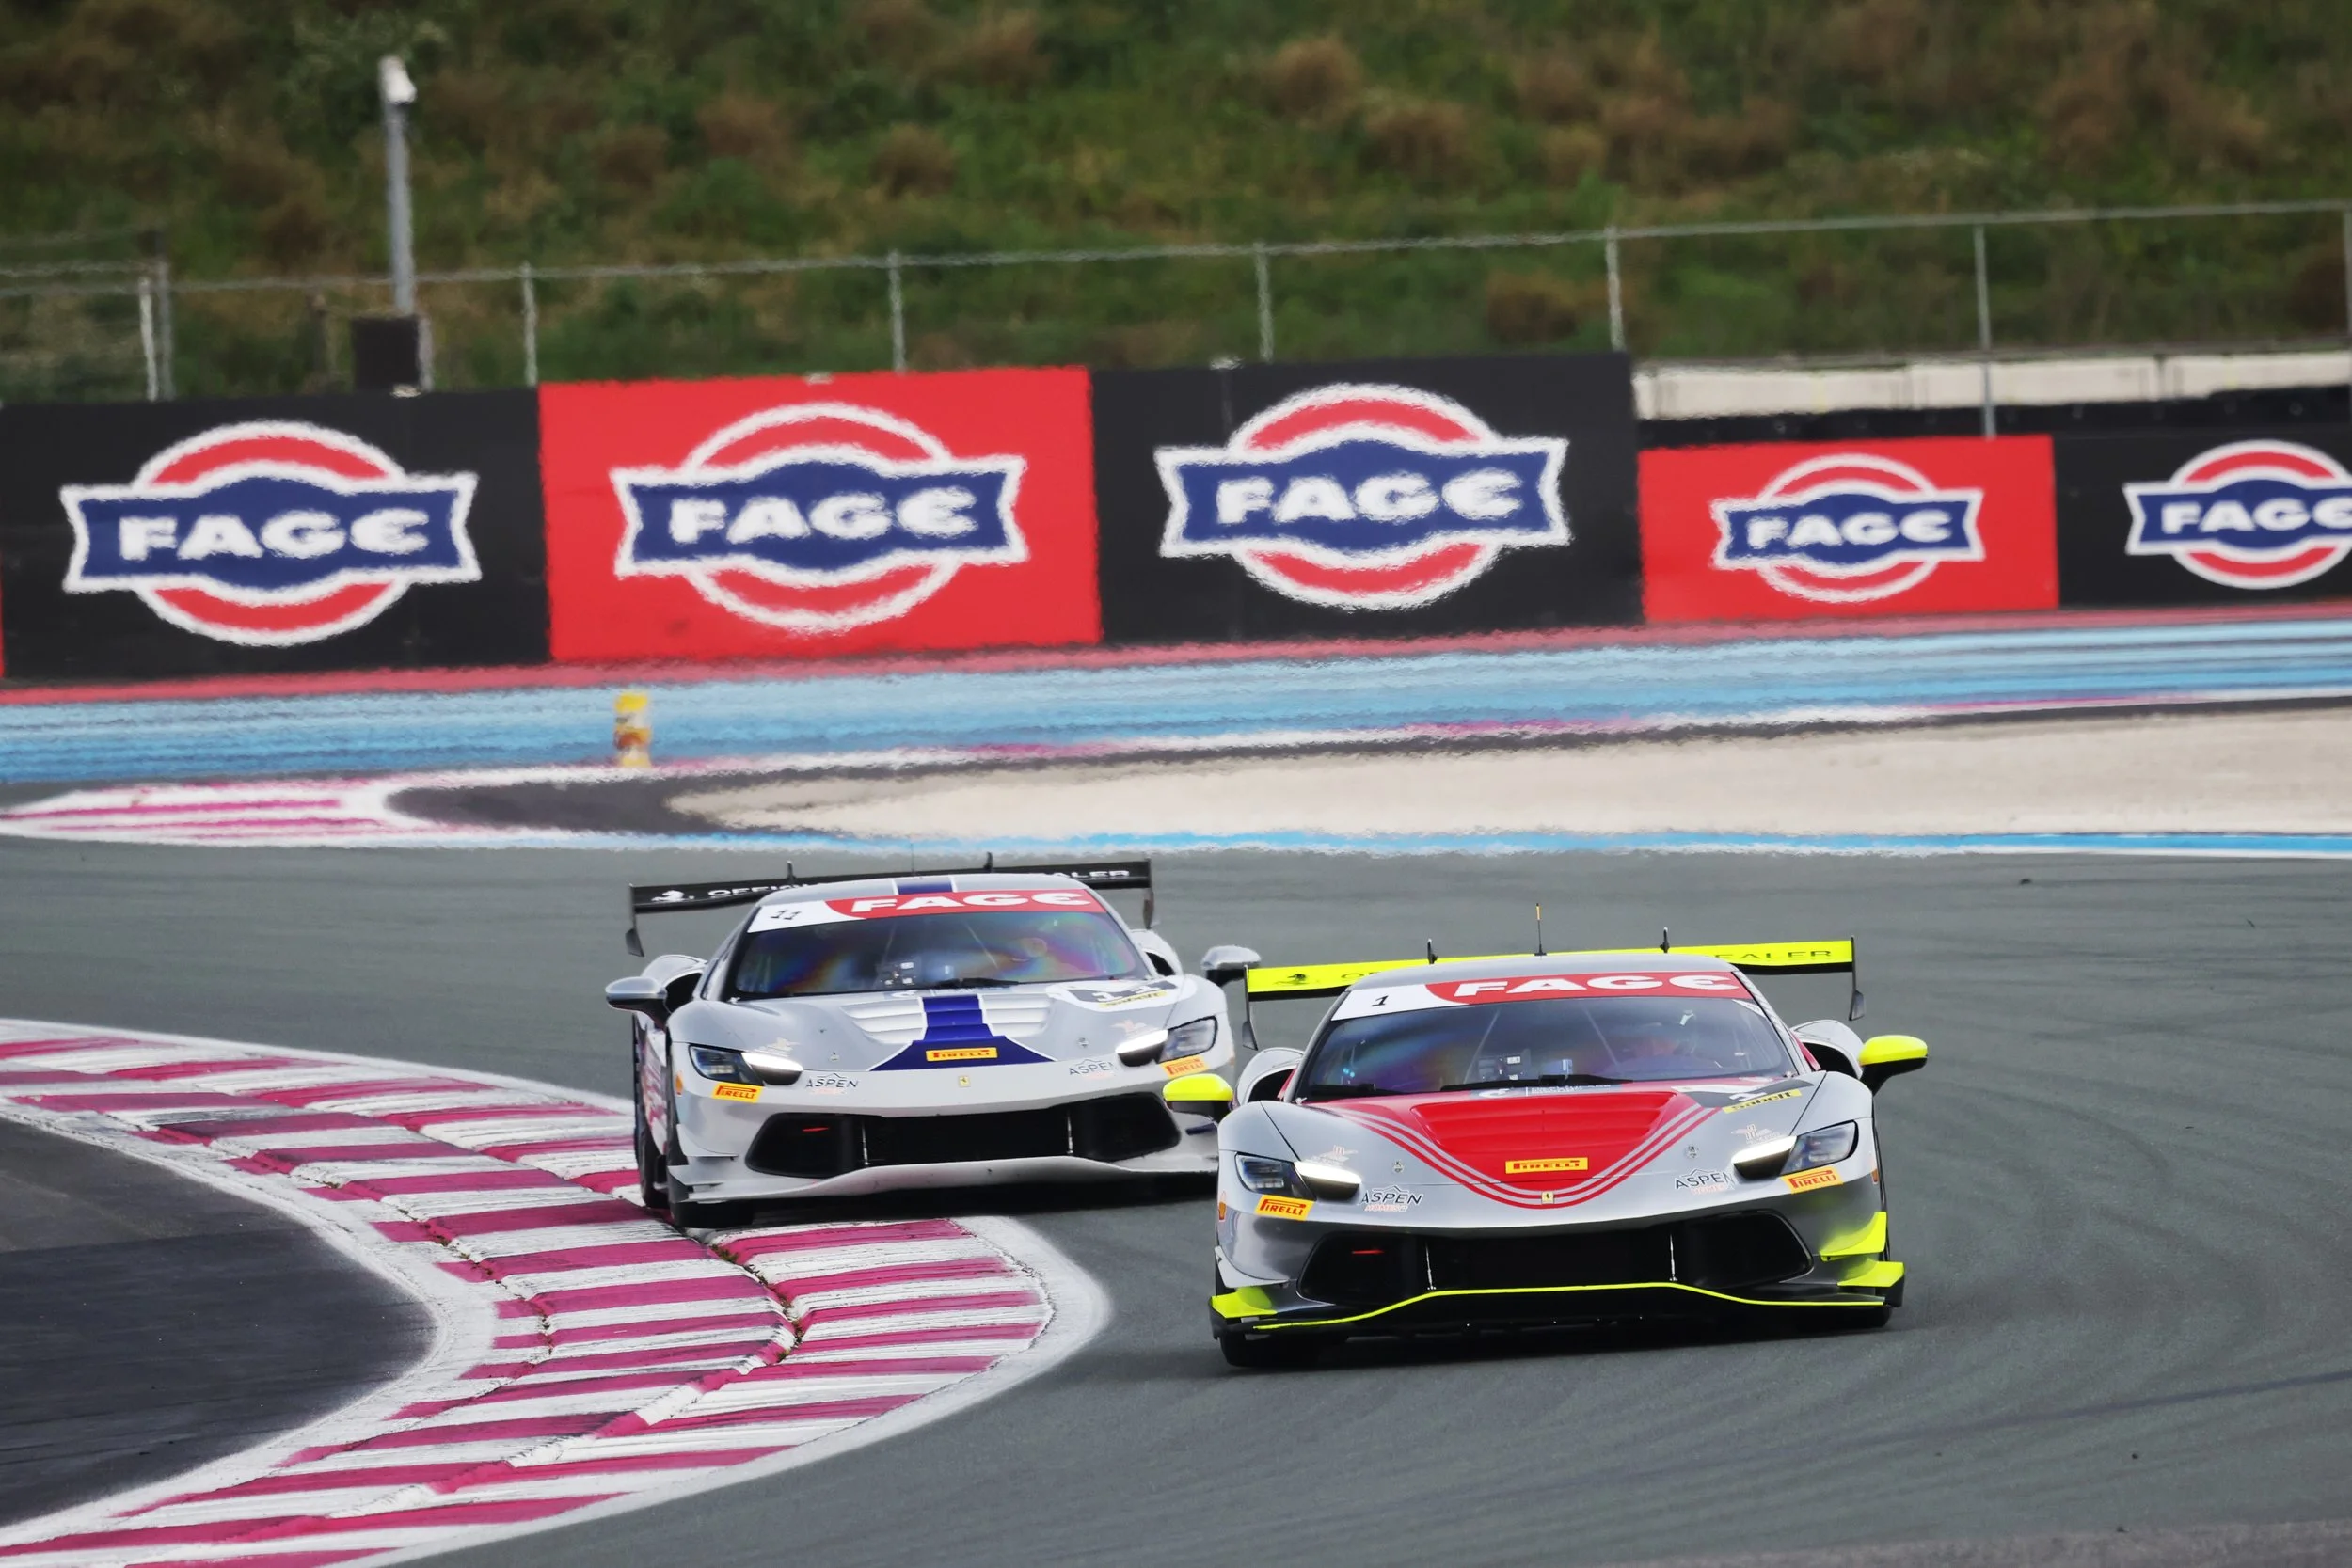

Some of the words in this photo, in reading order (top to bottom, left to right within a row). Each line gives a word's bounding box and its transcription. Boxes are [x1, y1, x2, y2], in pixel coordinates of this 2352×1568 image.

[1216, 467, 1524, 525] FAGE
[669, 486, 978, 545] FAGE
[119, 507, 430, 562] FAGE
[1746, 509, 1952, 550] FAGE
[850, 892, 1091, 913] FAGE
[1454, 975, 1740, 997] FAGE
[1371, 995, 1389, 1007] 1
[1166, 1058, 1205, 1075] PIRELLI
[715, 1085, 757, 1100] PIRELLI
[805, 1078, 859, 1088] ASPEN
[1788, 1170, 1837, 1189] PIRELLI
[1260, 1198, 1307, 1215] PIRELLI
[1360, 1192, 1423, 1204] ASPEN
